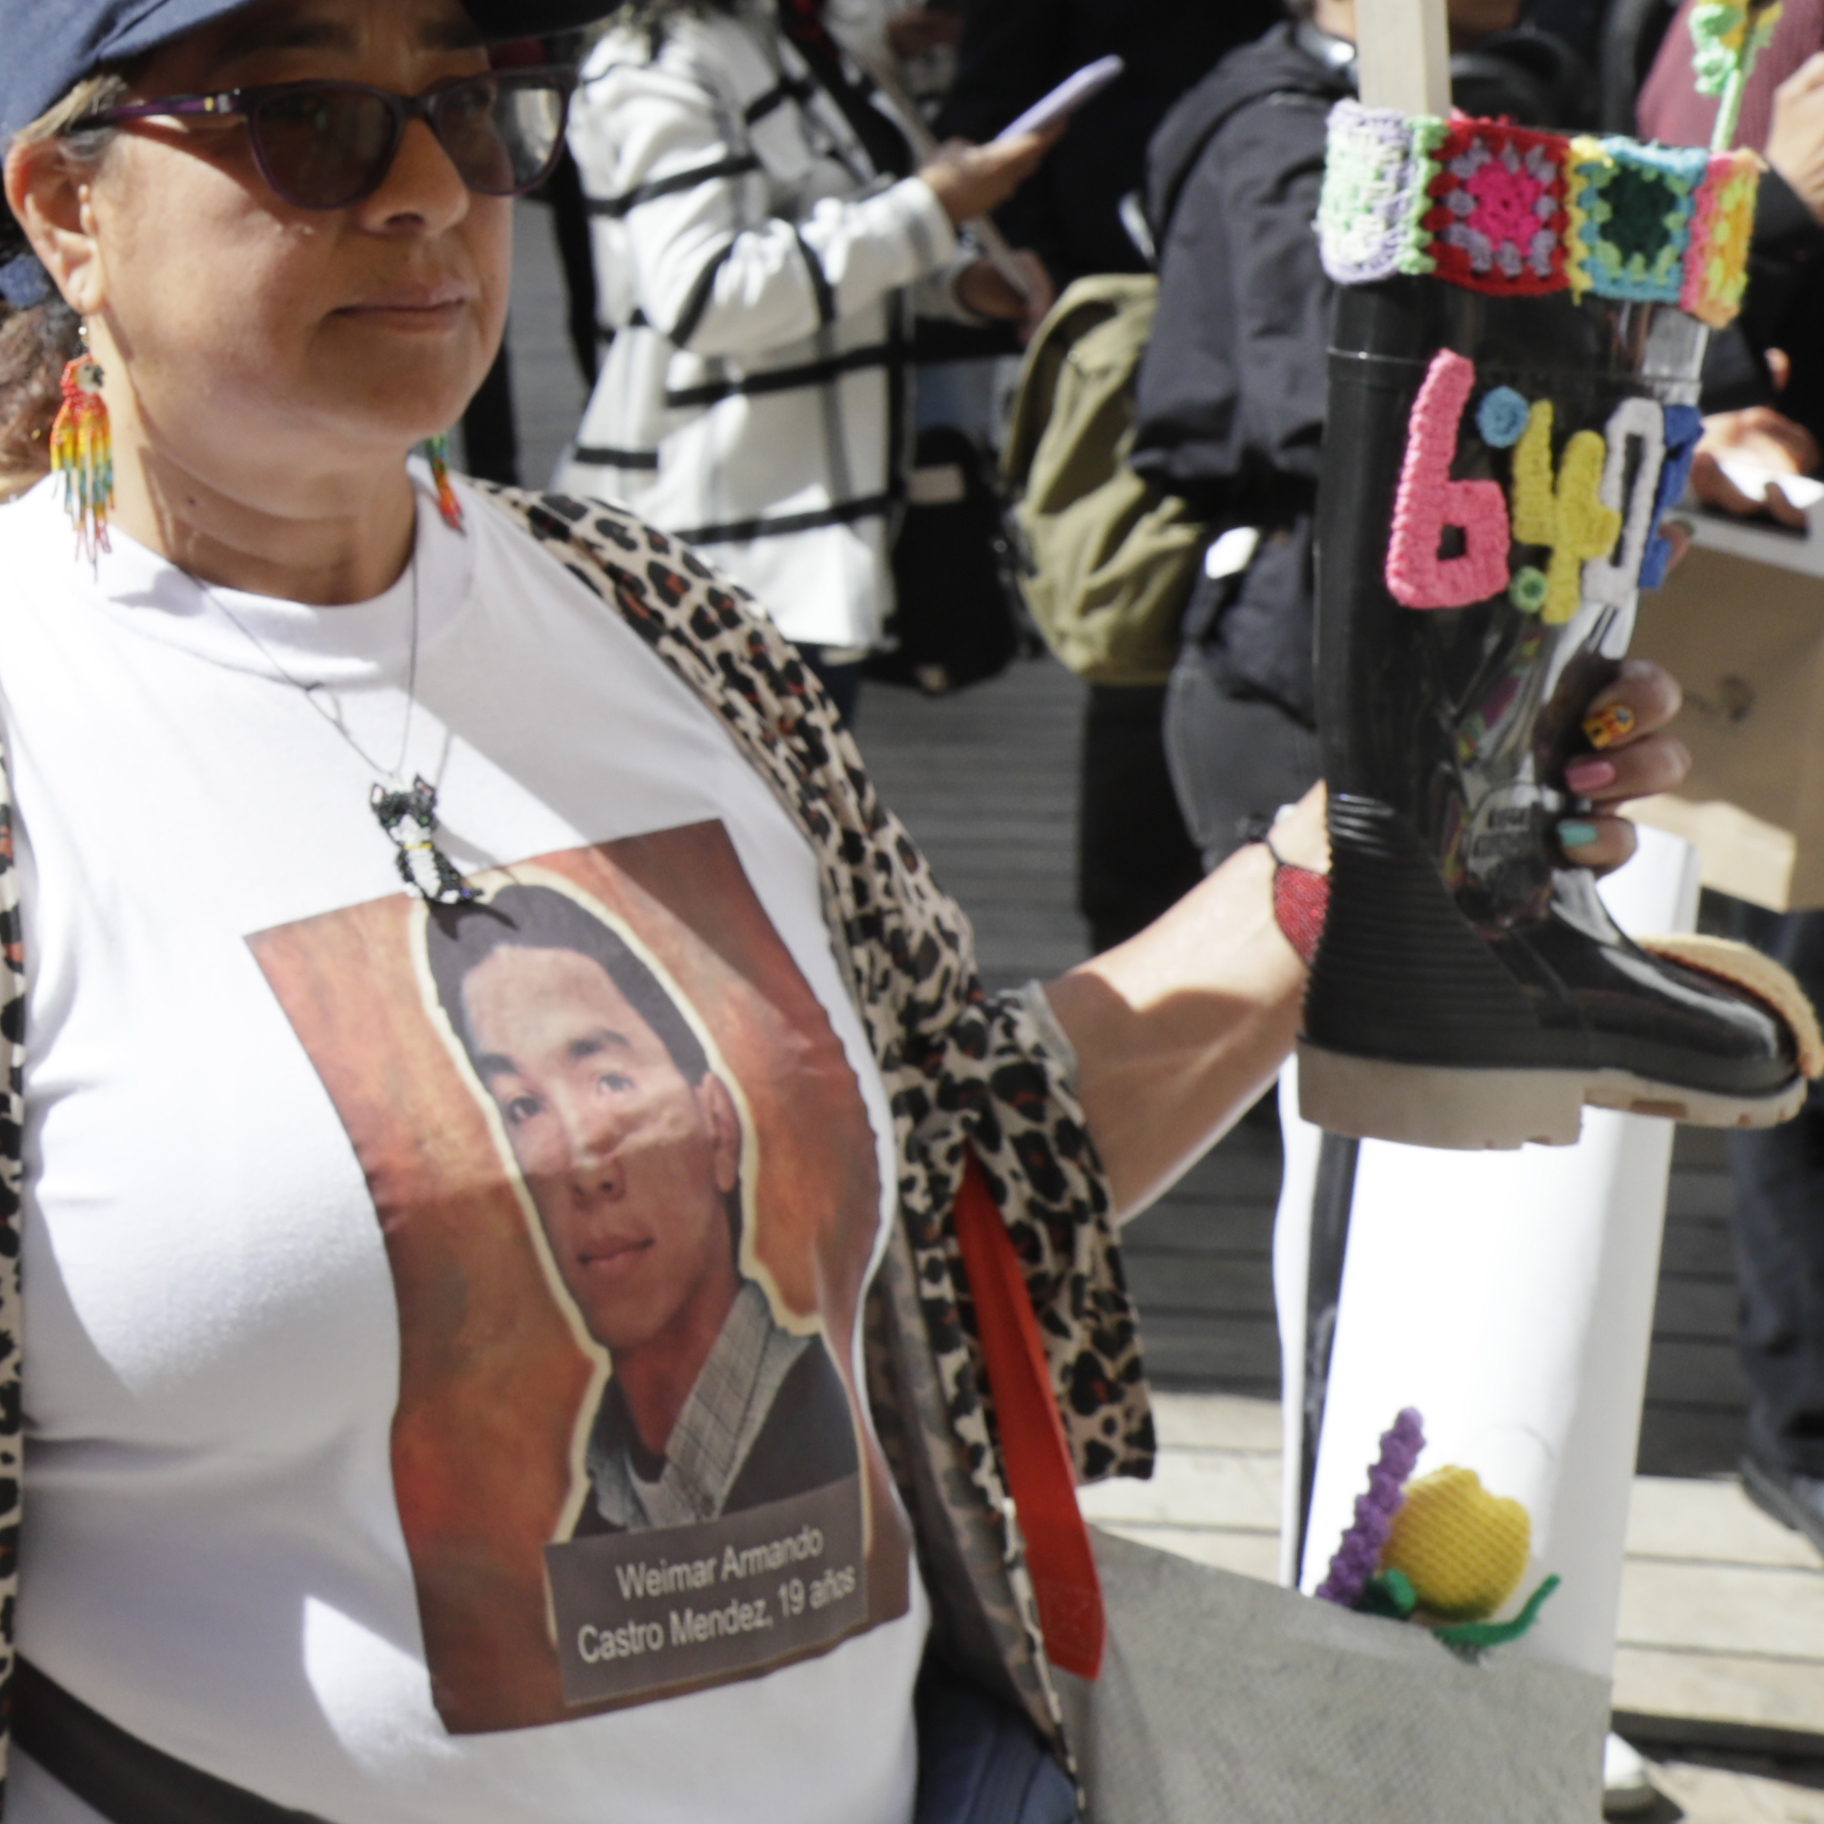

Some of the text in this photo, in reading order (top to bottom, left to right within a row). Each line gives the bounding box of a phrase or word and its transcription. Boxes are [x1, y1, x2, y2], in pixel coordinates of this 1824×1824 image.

[616, 1525, 824, 1601] Weimar Armando
[576, 1564, 857, 1665] Castro Mendez, 19 años
